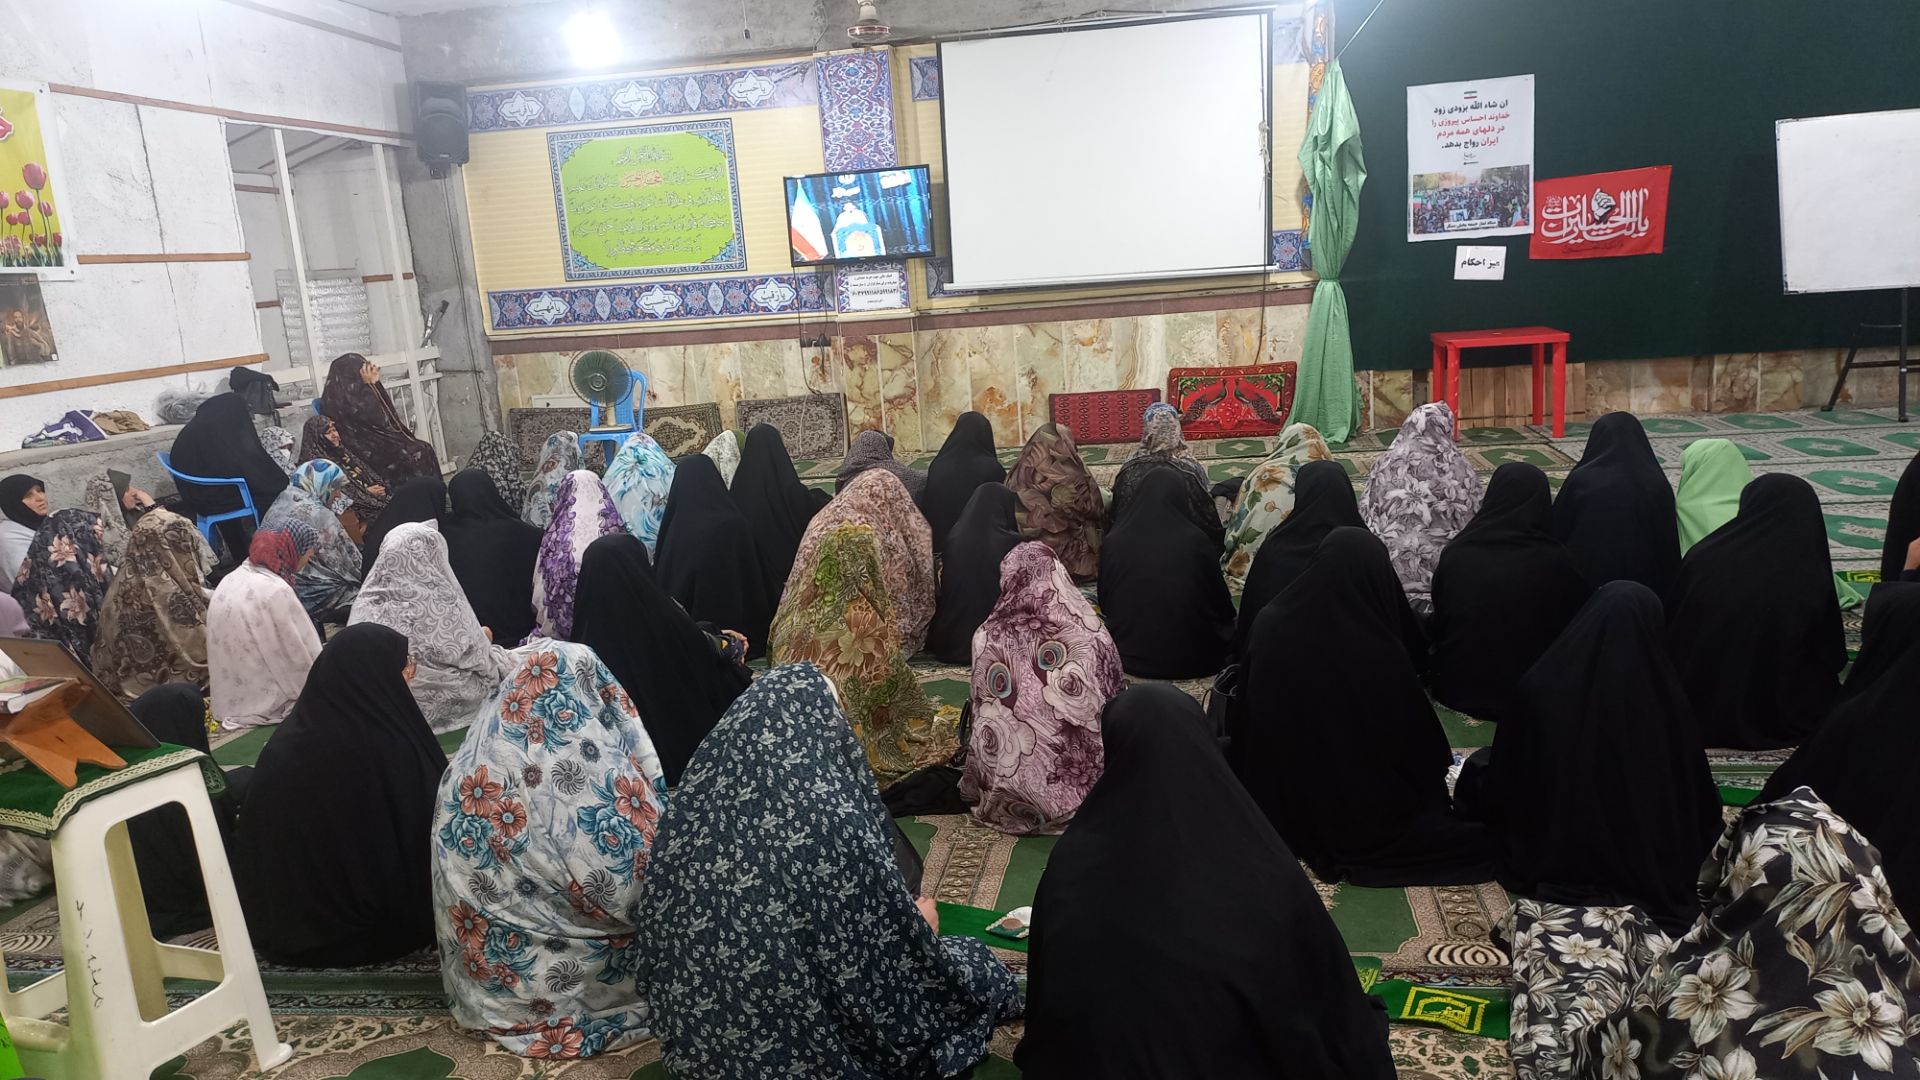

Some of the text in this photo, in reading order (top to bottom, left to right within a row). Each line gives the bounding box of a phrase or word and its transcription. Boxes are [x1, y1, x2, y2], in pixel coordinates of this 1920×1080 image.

[1433, 106, 1446, 115] زود
[1461, 114, 1486, 124] احساس
[1488, 111, 1511, 121] خداوند
[1438, 119, 1459, 127] پیروزی
[1472, 125, 1495, 135] دلهای
[1496, 125, 1505, 134] در
[1437, 130, 1454, 140] مردم
[1463, 139, 1479, 149] رواج
[1480, 136, 1499, 147] ایران
[1461, 257, 1485, 269] احکام
